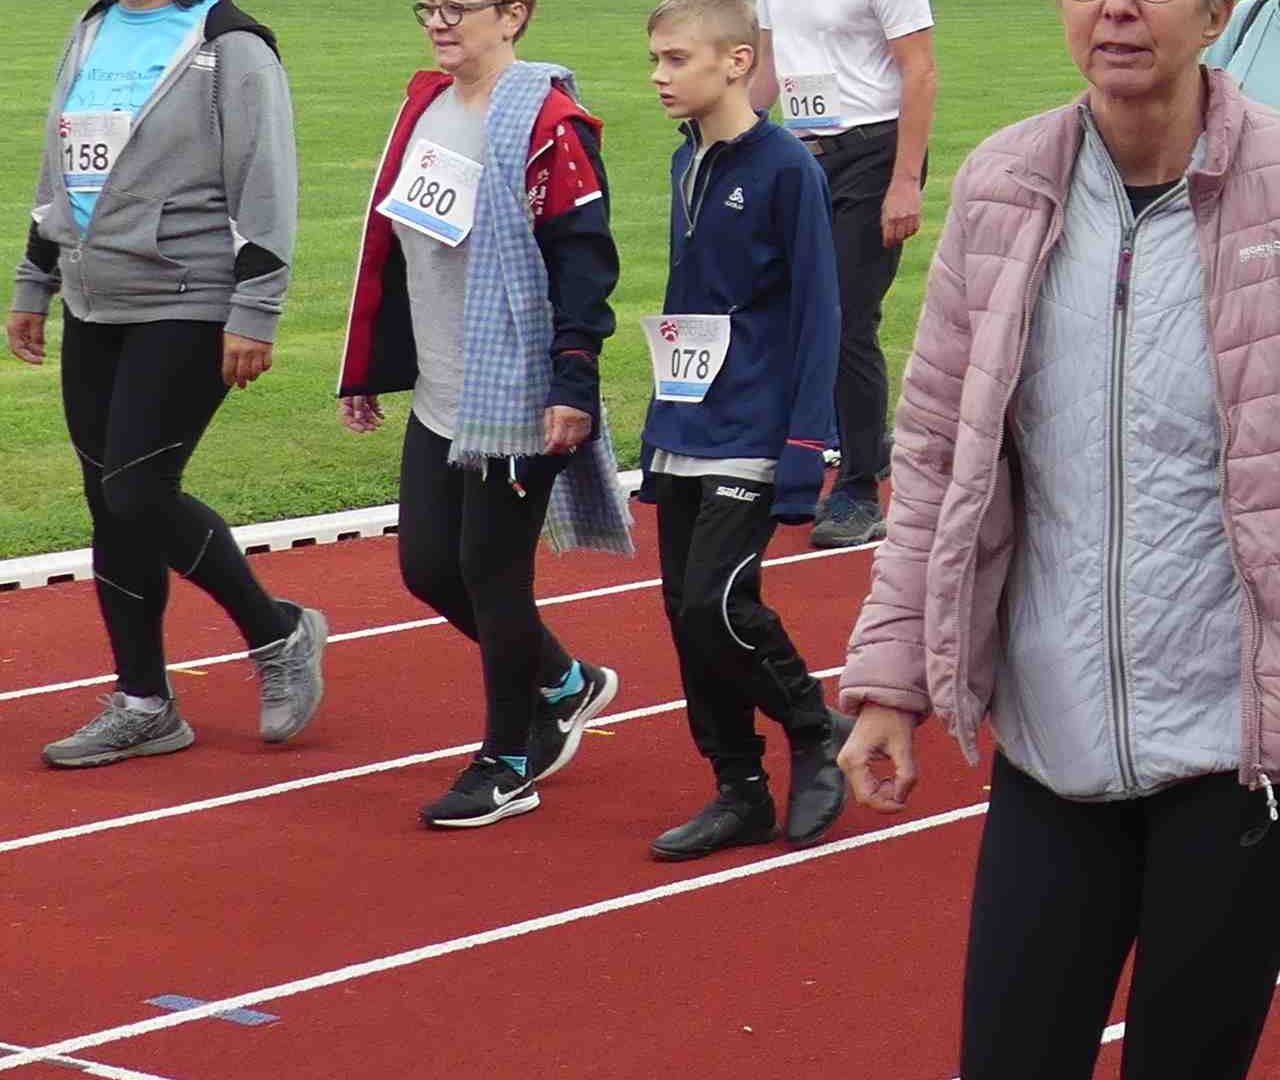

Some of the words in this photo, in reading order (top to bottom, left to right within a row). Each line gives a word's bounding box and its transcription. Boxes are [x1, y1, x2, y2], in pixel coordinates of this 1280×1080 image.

[790, 95, 825, 117] 016
[65, 143, 109, 171] 158
[407, 175, 457, 216] 080
[671, 348, 711, 380] 078
